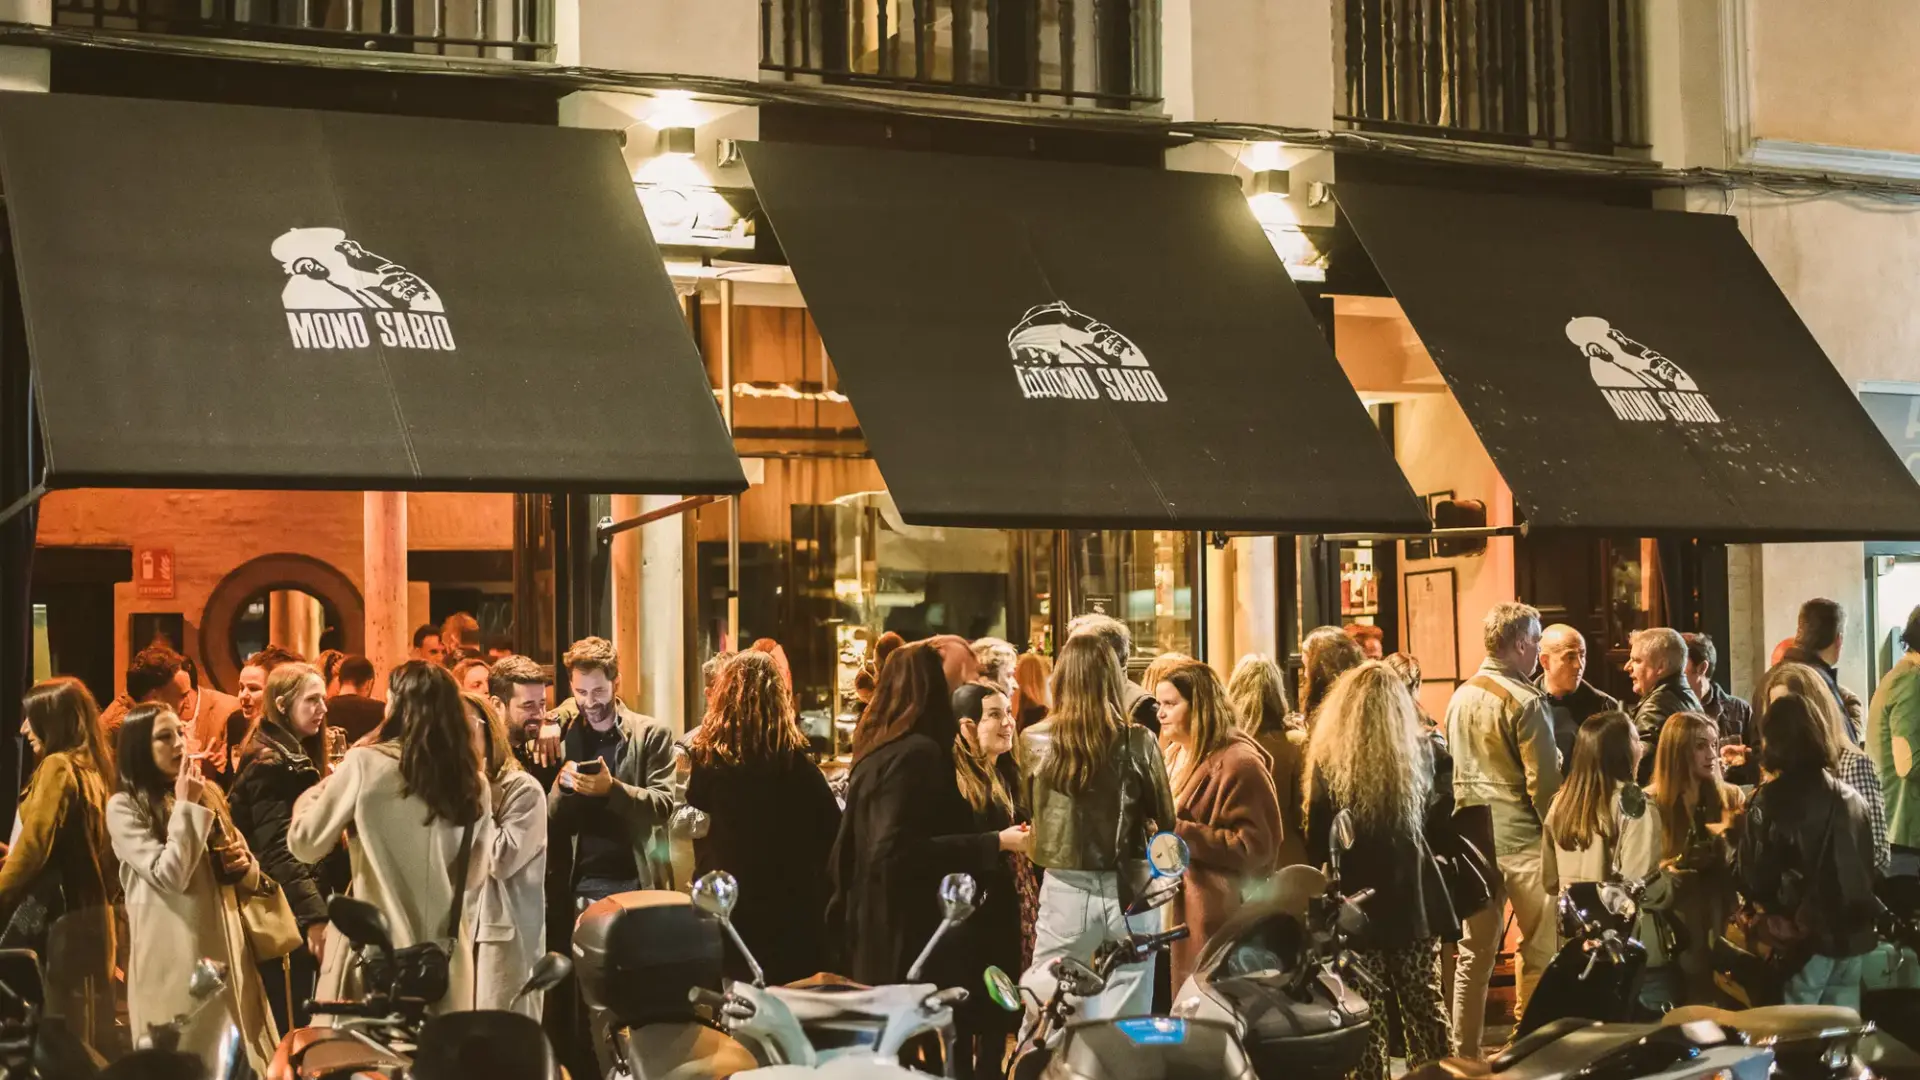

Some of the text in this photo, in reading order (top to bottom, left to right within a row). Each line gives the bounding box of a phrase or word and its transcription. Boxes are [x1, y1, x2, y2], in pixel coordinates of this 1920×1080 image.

[286, 311, 456, 351] MONO SABIO
[1096, 367, 1168, 402] SABIO
[1600, 389, 1720, 423] MONO SABIO
